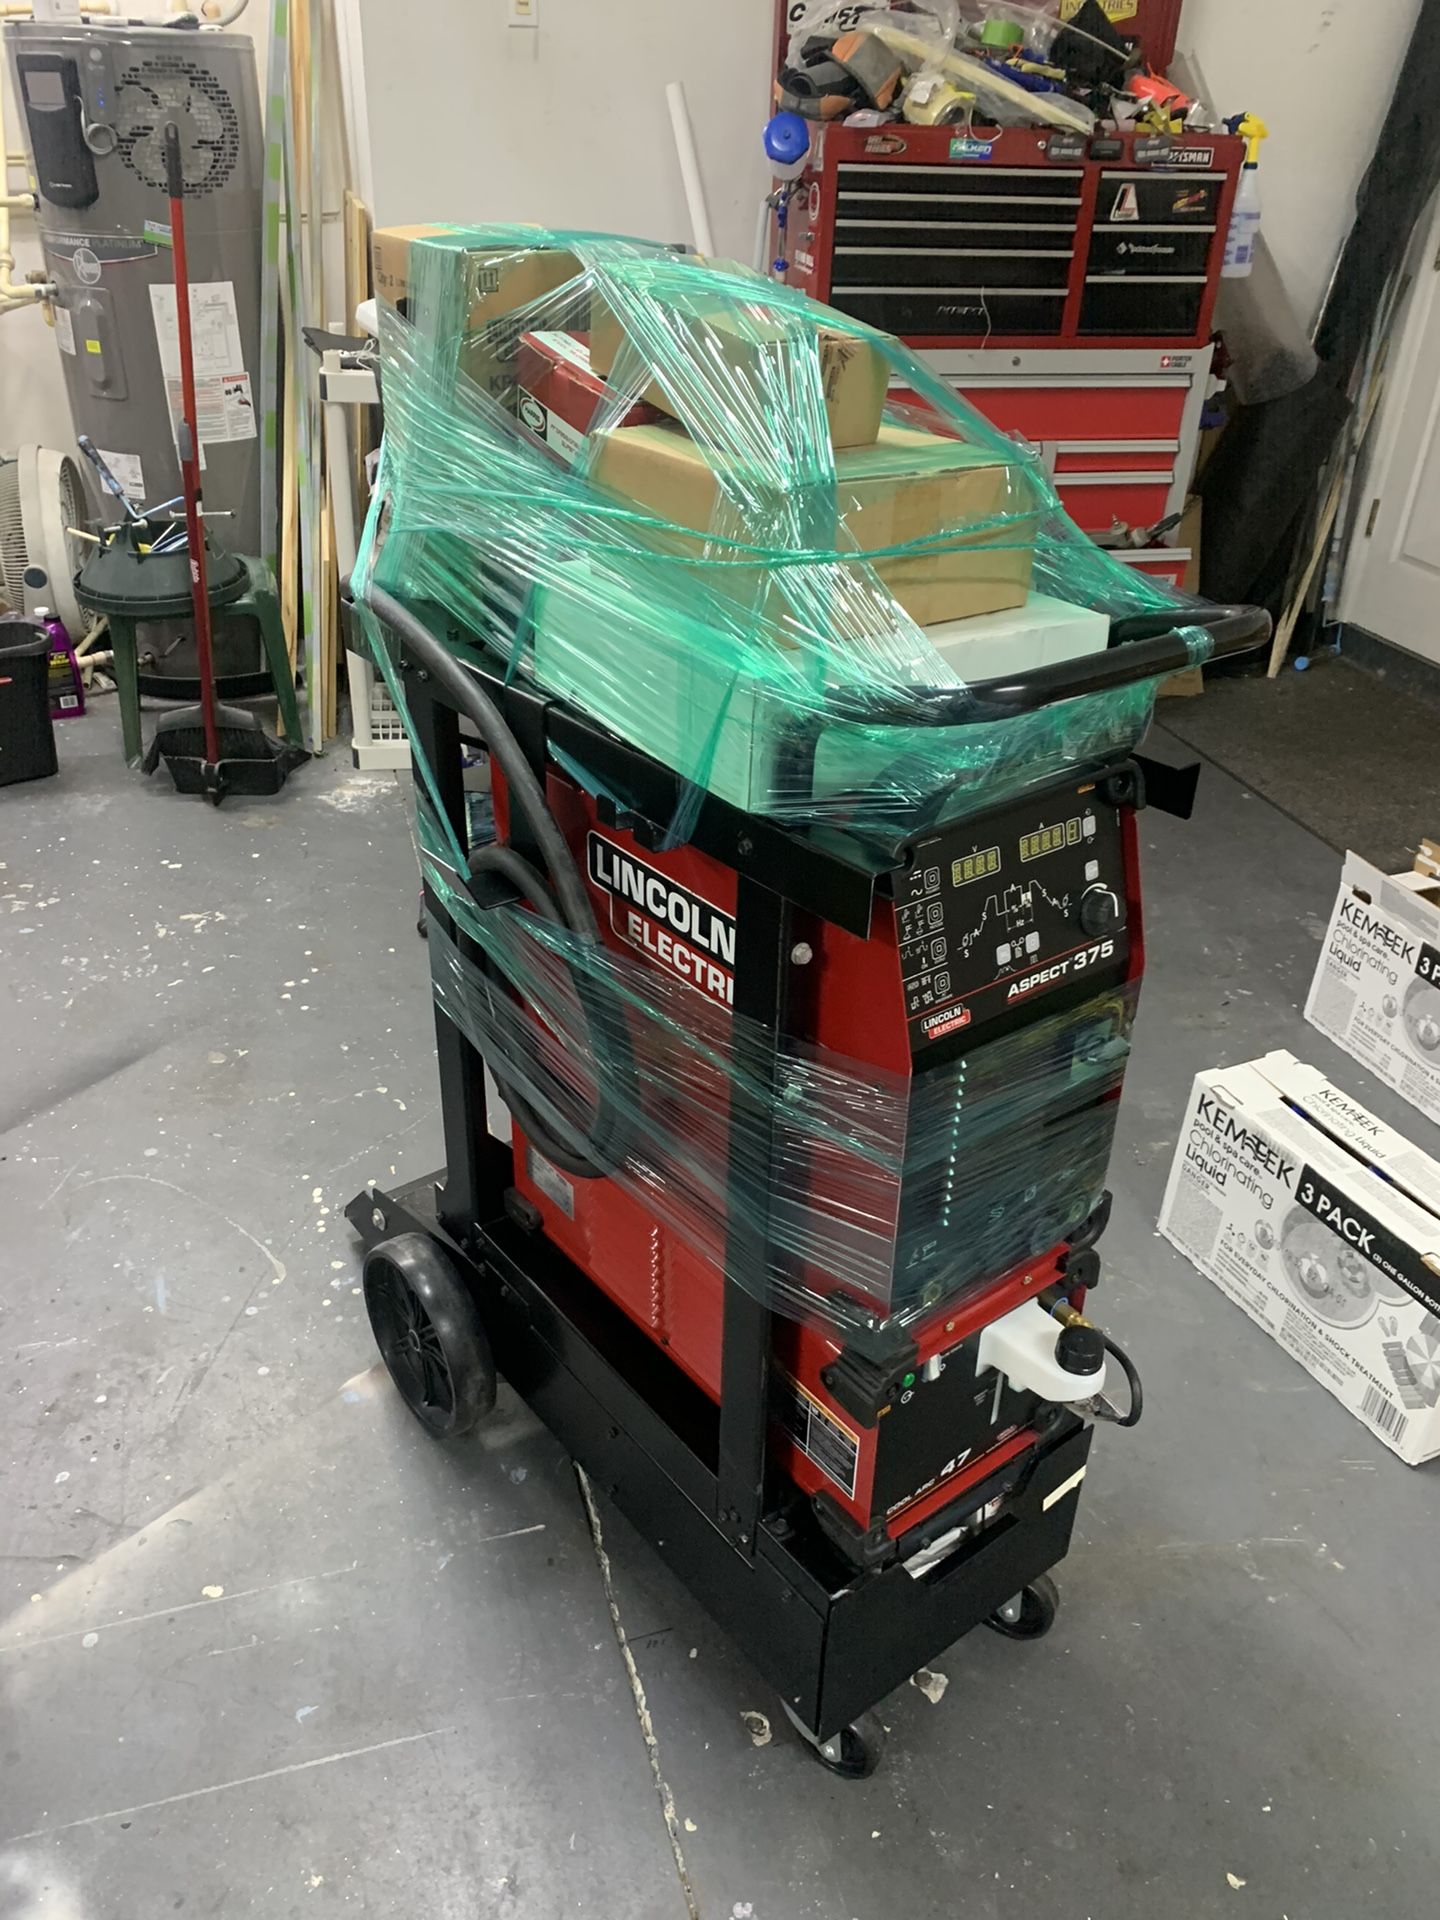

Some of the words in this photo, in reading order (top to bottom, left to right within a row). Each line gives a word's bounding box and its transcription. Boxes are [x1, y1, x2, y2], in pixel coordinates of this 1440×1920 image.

[596, 843, 736, 966] LINCOLN
[627, 910, 735, 1005] ELECTRI
[1007, 961, 1069, 998] ASPECT
[1073, 939, 1114, 971] 375
[1329, 941, 1362, 972] Liquid
[1333, 929, 1398, 985] Chlorinating
[1419, 956, 1431, 974] 3
[923, 1006, 962, 1030] LINCOLN
[933, 1015, 967, 1035] ELECTRIC
[1193, 1118, 1215, 1139] pool
[1214, 1134, 1222, 1145] &
[1222, 1142, 1239, 1159] spa
[1355, 1136, 1386, 1159] Liquid
[1185, 1143, 1227, 1187] Liquid
[1189, 1129, 1274, 1210] Chlorinating
[1300, 1182, 1315, 1204] 3
[1316, 1194, 1376, 1255] PACK
[1382, 1260, 1399, 1278] ONE
[1396, 1273, 1425, 1300] GALLON
[1424, 1296, 1440, 1314] BOTT
[1220, 1239, 1234, 1253] FOR
[1234, 1250, 1267, 1283] EVERYDAY
[1266, 1281, 1318, 1331] CHLORINATION
[1324, 1333, 1350, 1360] SHOCK
[1351, 1358, 1394, 1399] TREATMENT
[940, 1447, 972, 1477] 47
